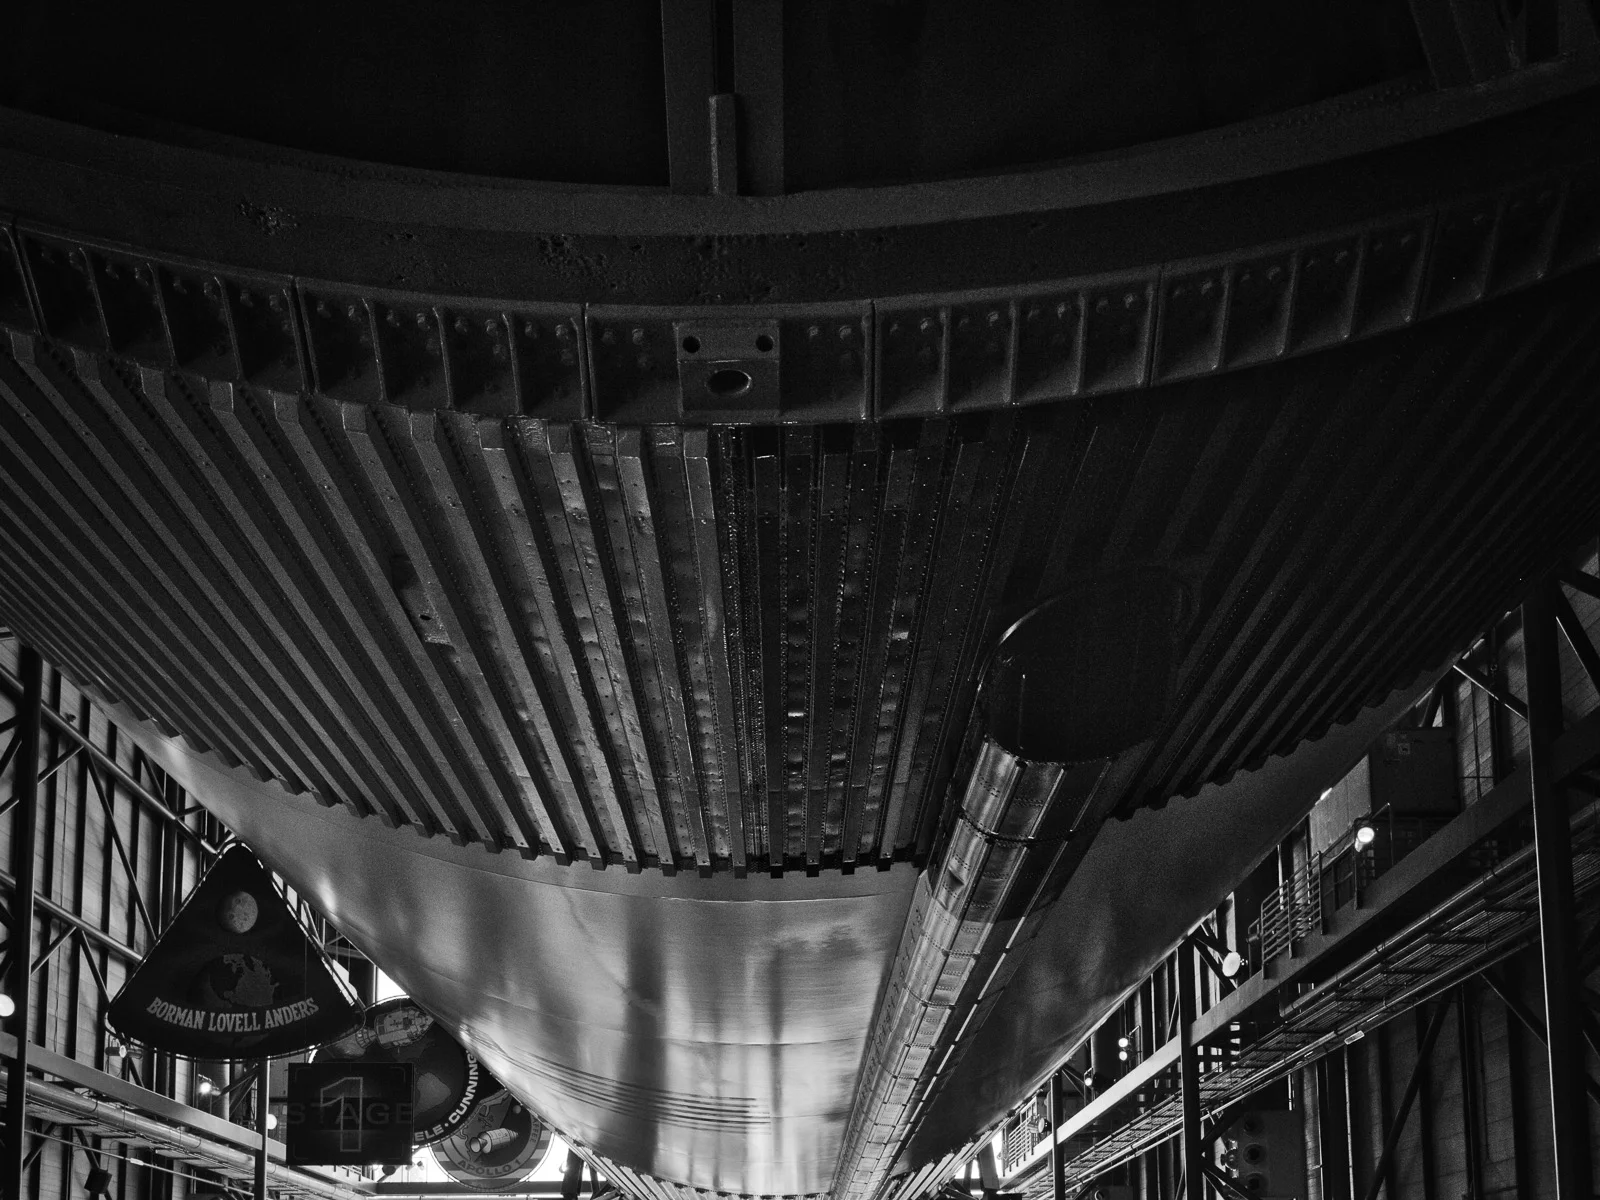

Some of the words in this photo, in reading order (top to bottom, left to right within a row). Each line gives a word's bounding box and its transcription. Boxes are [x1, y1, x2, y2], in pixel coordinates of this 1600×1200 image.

[146, 997, 206, 1030] BORMAN
[208, 1012, 261, 1032] LOVELL
[265, 997, 319, 1029] ANDERS
[448, 1050, 479, 1124] CUNNING
[287, 1102, 413, 1125] STAGE
[458, 1160, 511, 1176] APOLLO
